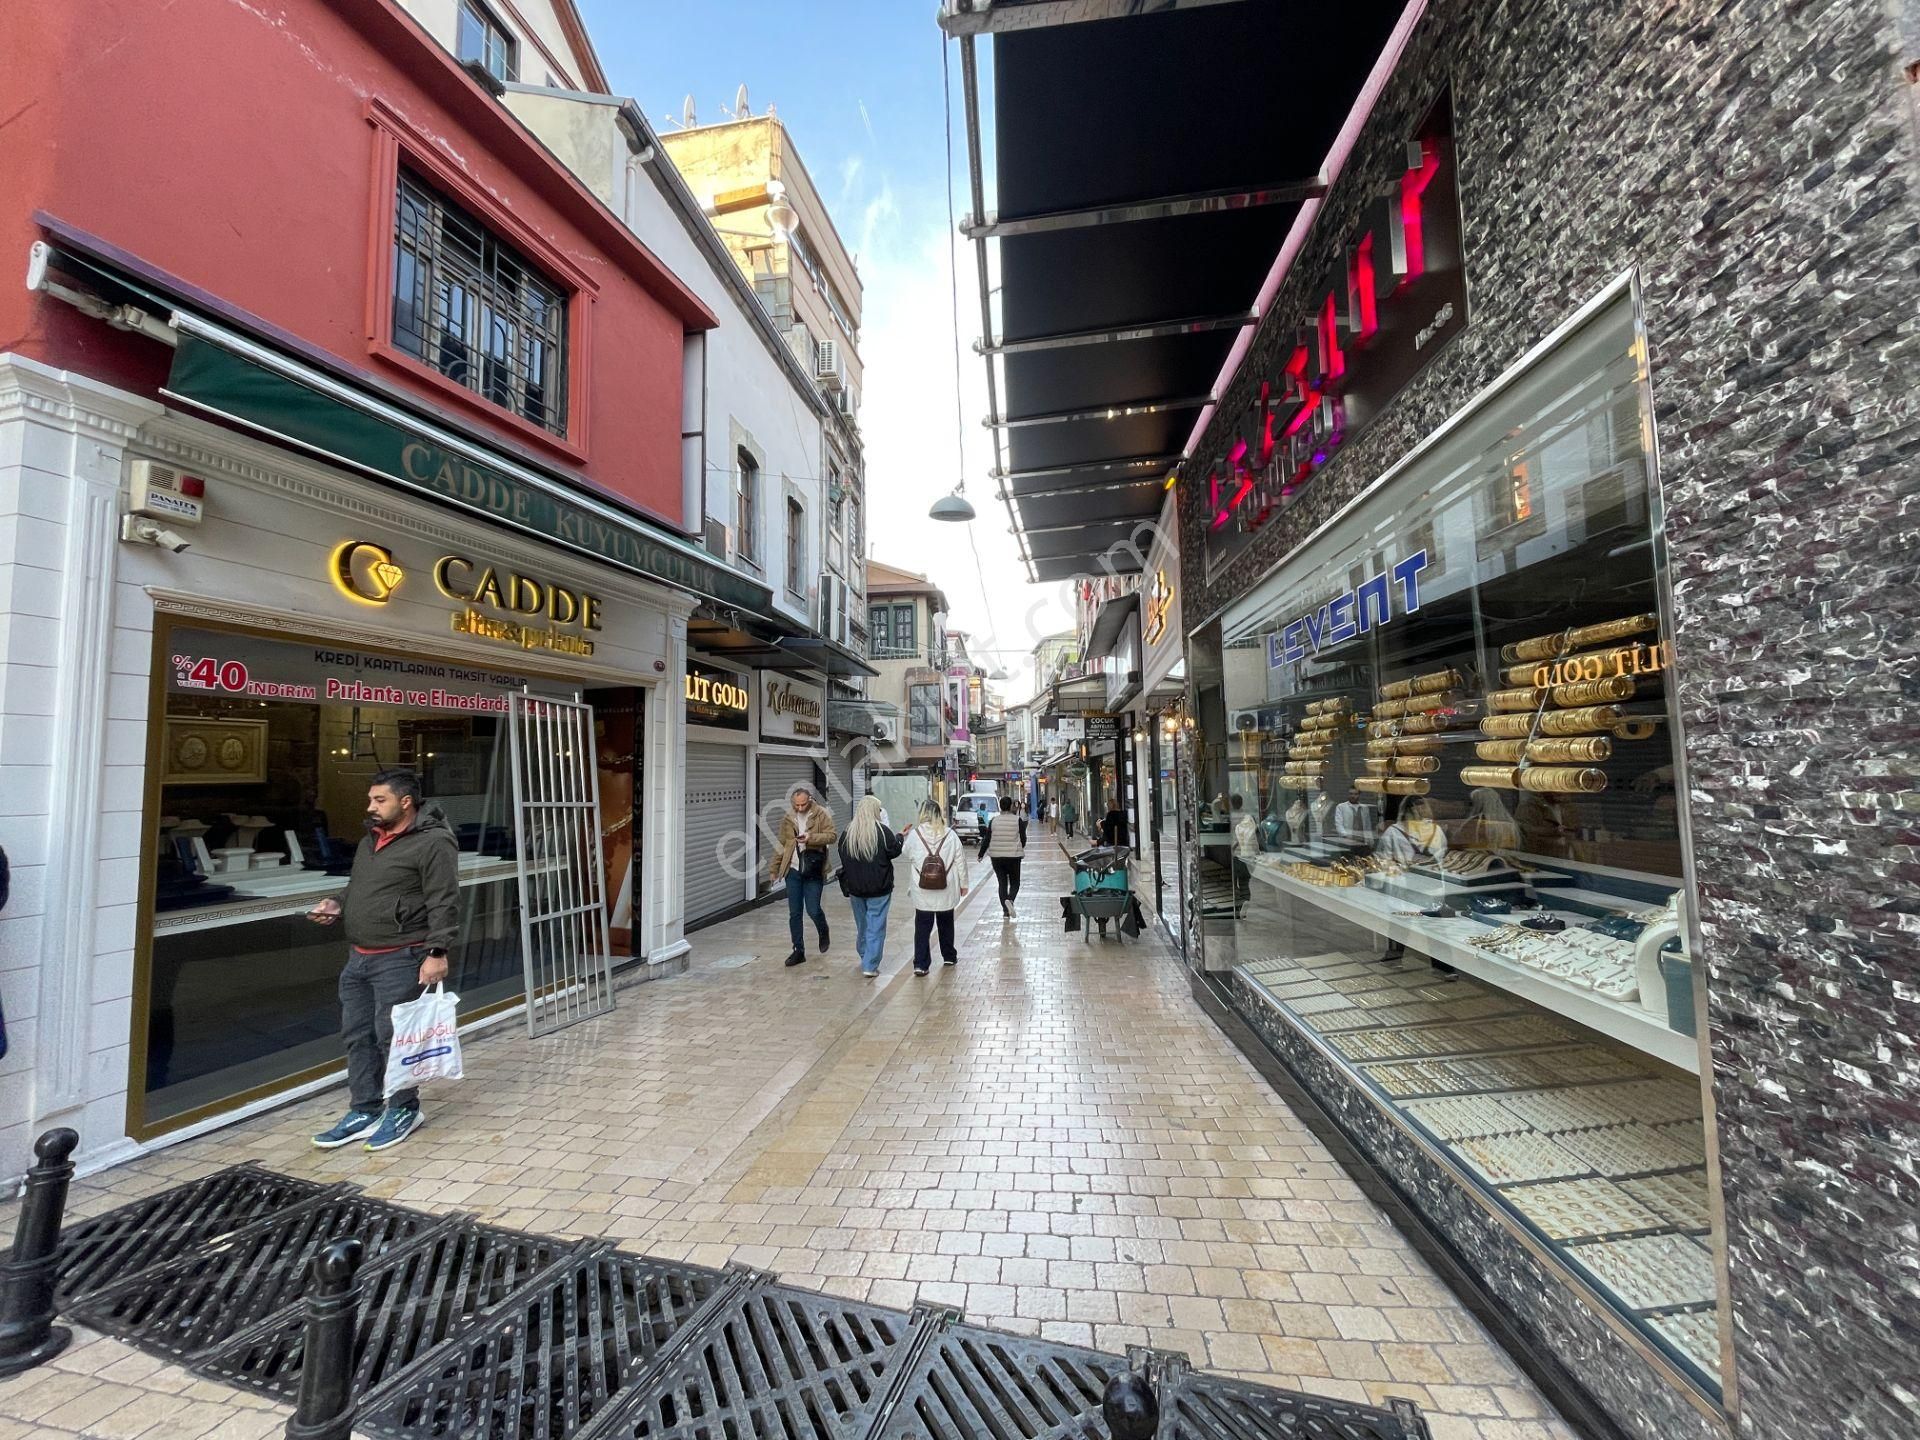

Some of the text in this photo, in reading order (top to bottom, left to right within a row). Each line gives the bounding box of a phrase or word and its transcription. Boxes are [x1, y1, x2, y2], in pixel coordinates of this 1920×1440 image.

[402, 443, 717, 597] CADDE KUYUMCULUK
[433, 555, 602, 631] CADDE
[1268, 548, 1428, 669] LEVENT
[314, 650, 360, 667] KREDİ
[363, 656, 446, 679] KARTLARINA
[448, 667, 488, 685] TAKSİT
[326, 678, 404, 705] Pırlanta
[406, 691, 428, 706] ve
[430, 689, 511, 713] Elmaslarda
[685, 669, 748, 710] LİT GOLD
